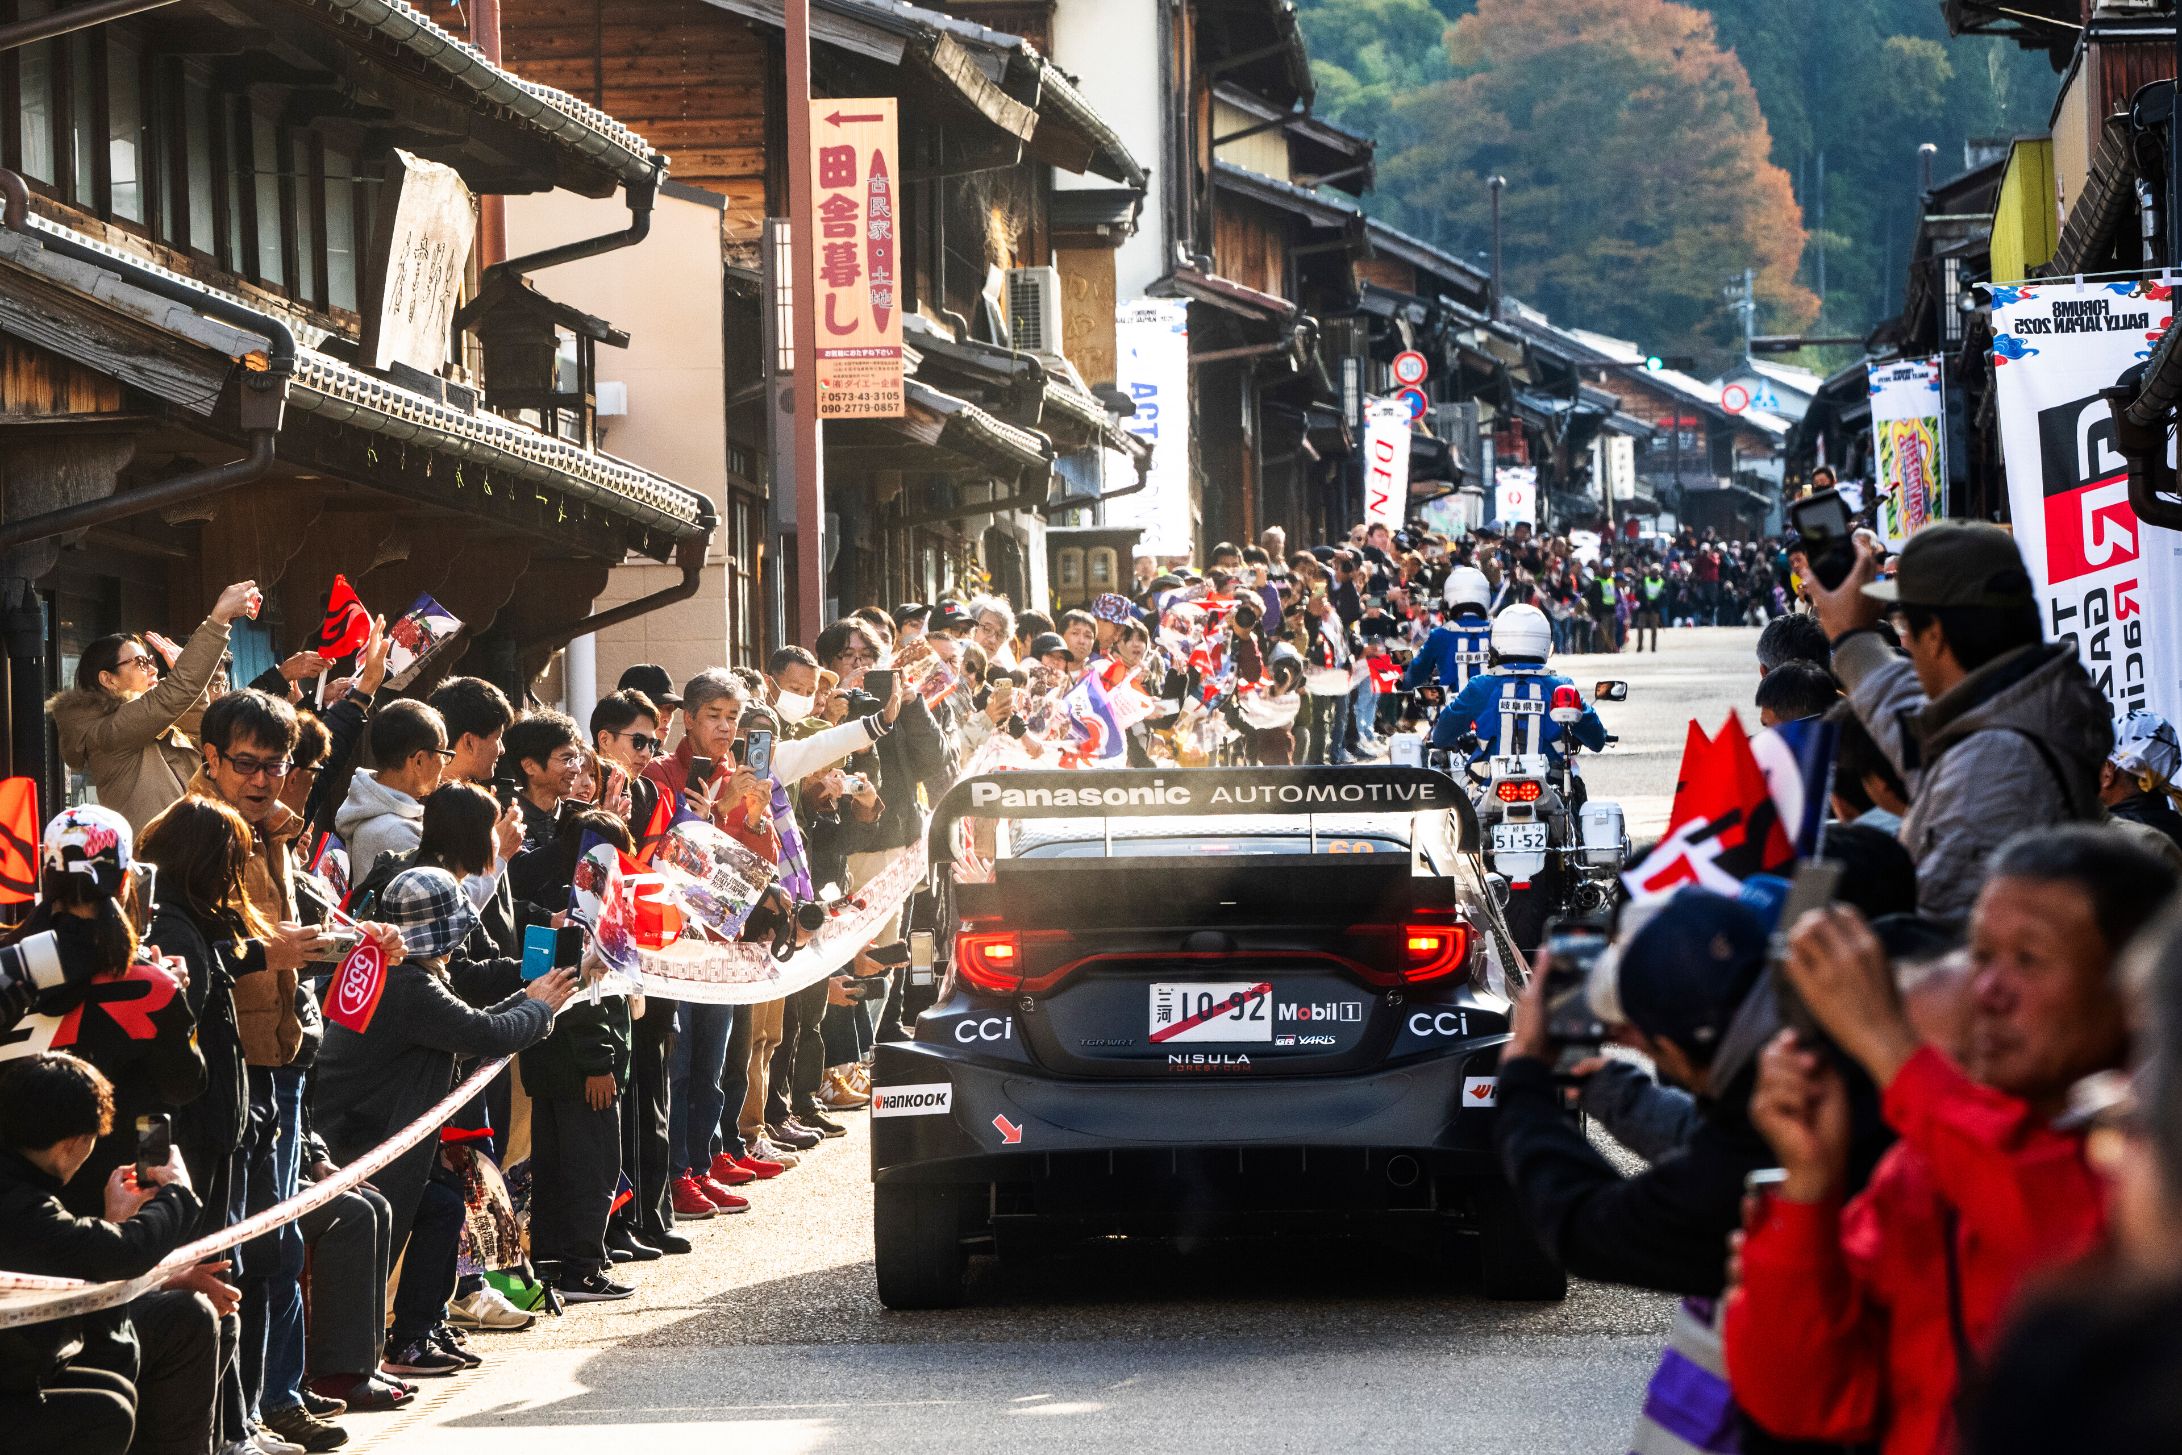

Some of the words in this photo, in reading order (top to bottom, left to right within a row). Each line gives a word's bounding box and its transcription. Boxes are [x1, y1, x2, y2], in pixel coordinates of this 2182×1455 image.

[818, 144, 861, 336] 田舎暮し
[866, 172, 893, 308] 古民家・土地
[1402, 361, 1419, 376] 30
[828, 392, 900, 402] 0573-43-3105
[821, 402, 900, 413] 090-2779-0857
[1501, 700, 1543, 713] 岐阜県警
[971, 779, 1190, 807] Panasonic
[1211, 782, 1436, 803] AUTOMOTIVE
[1495, 834, 1544, 849] 51-52
[344, 952, 375, 1005] 555
[1157, 991, 1172, 1024] 三河
[1182, 991, 1265, 1022] 10-92
[1278, 1003, 1337, 1020] Mobil
[1080, 1039, 1105, 1047] TGR
[1107, 1039, 1135, 1047] WRT
[1275, 1035, 1296, 1046] GR
[1168, 1054, 1250, 1065] NISULA
